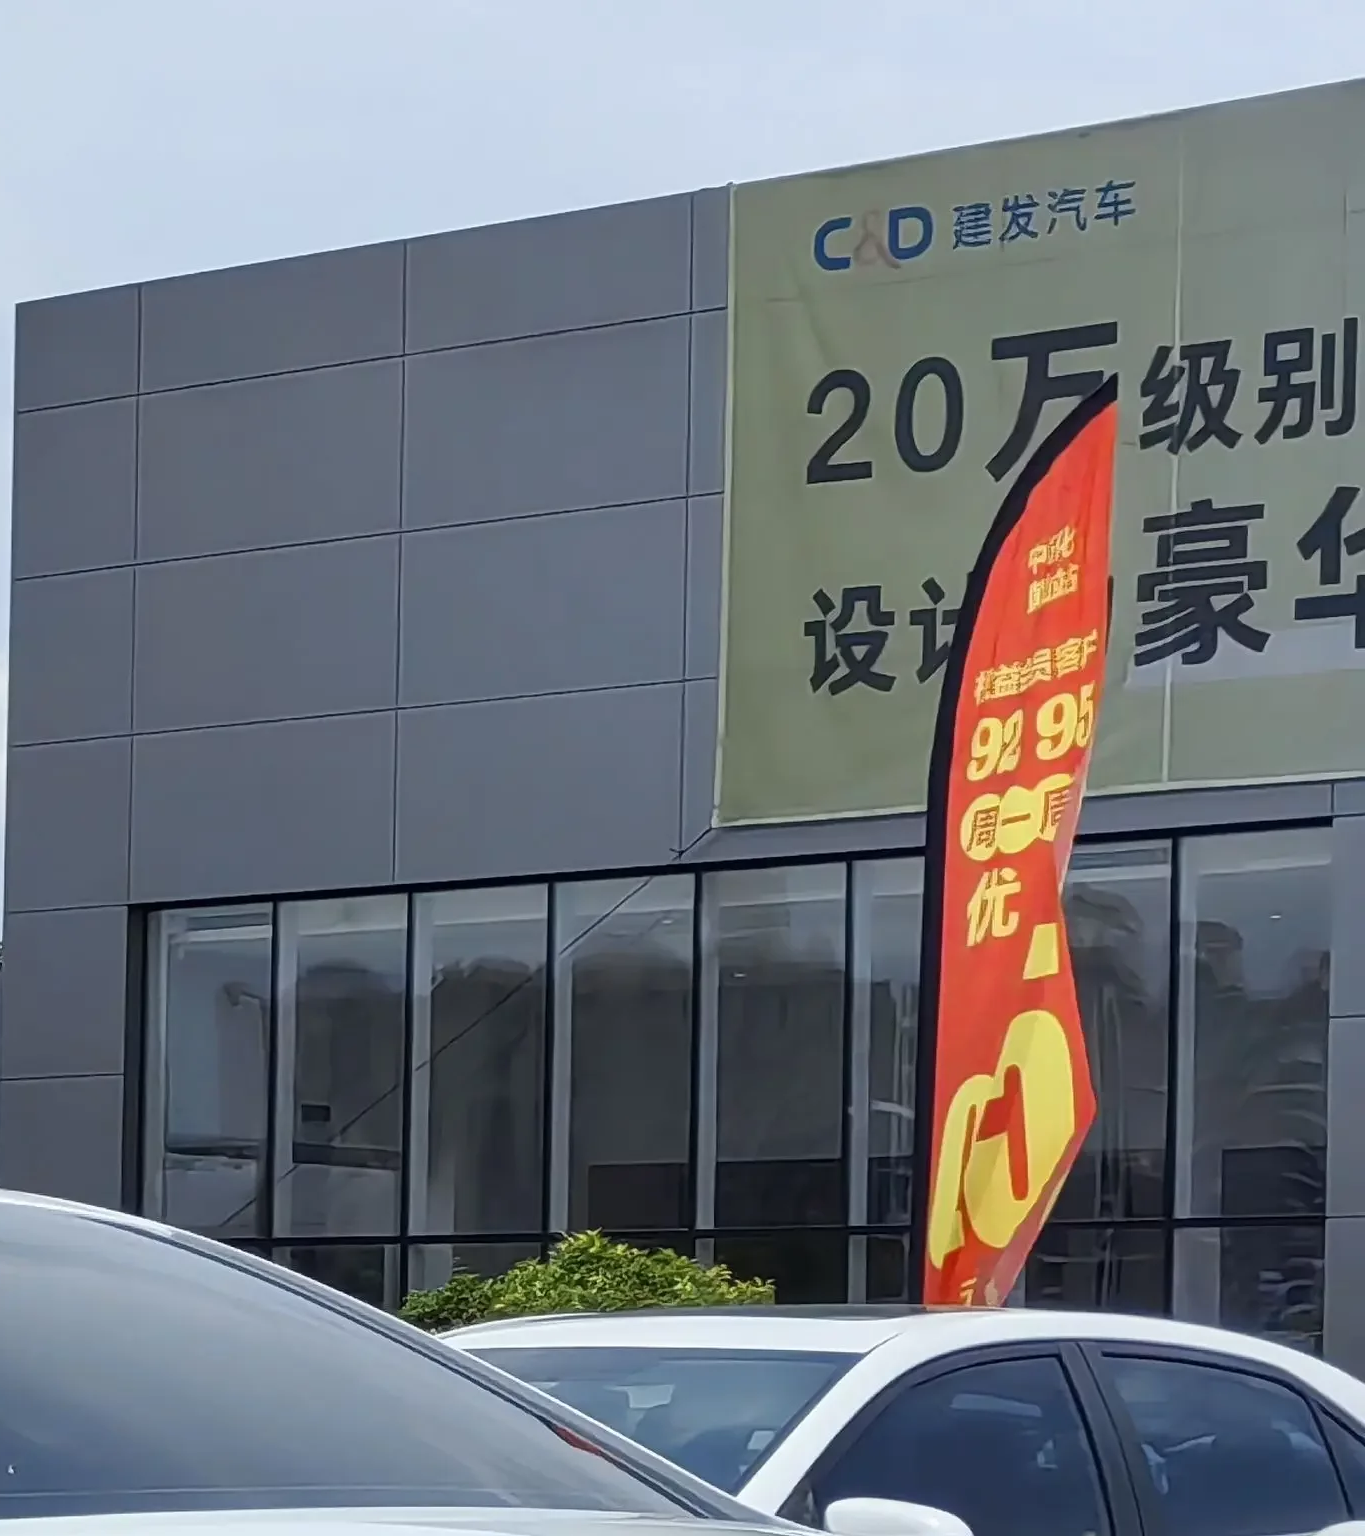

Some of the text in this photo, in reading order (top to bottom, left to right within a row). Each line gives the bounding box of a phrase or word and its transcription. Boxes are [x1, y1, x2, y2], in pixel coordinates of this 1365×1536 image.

[813, 179, 1137, 271] C&D 建发汽车
[966, 680, 1097, 781] 92 95
